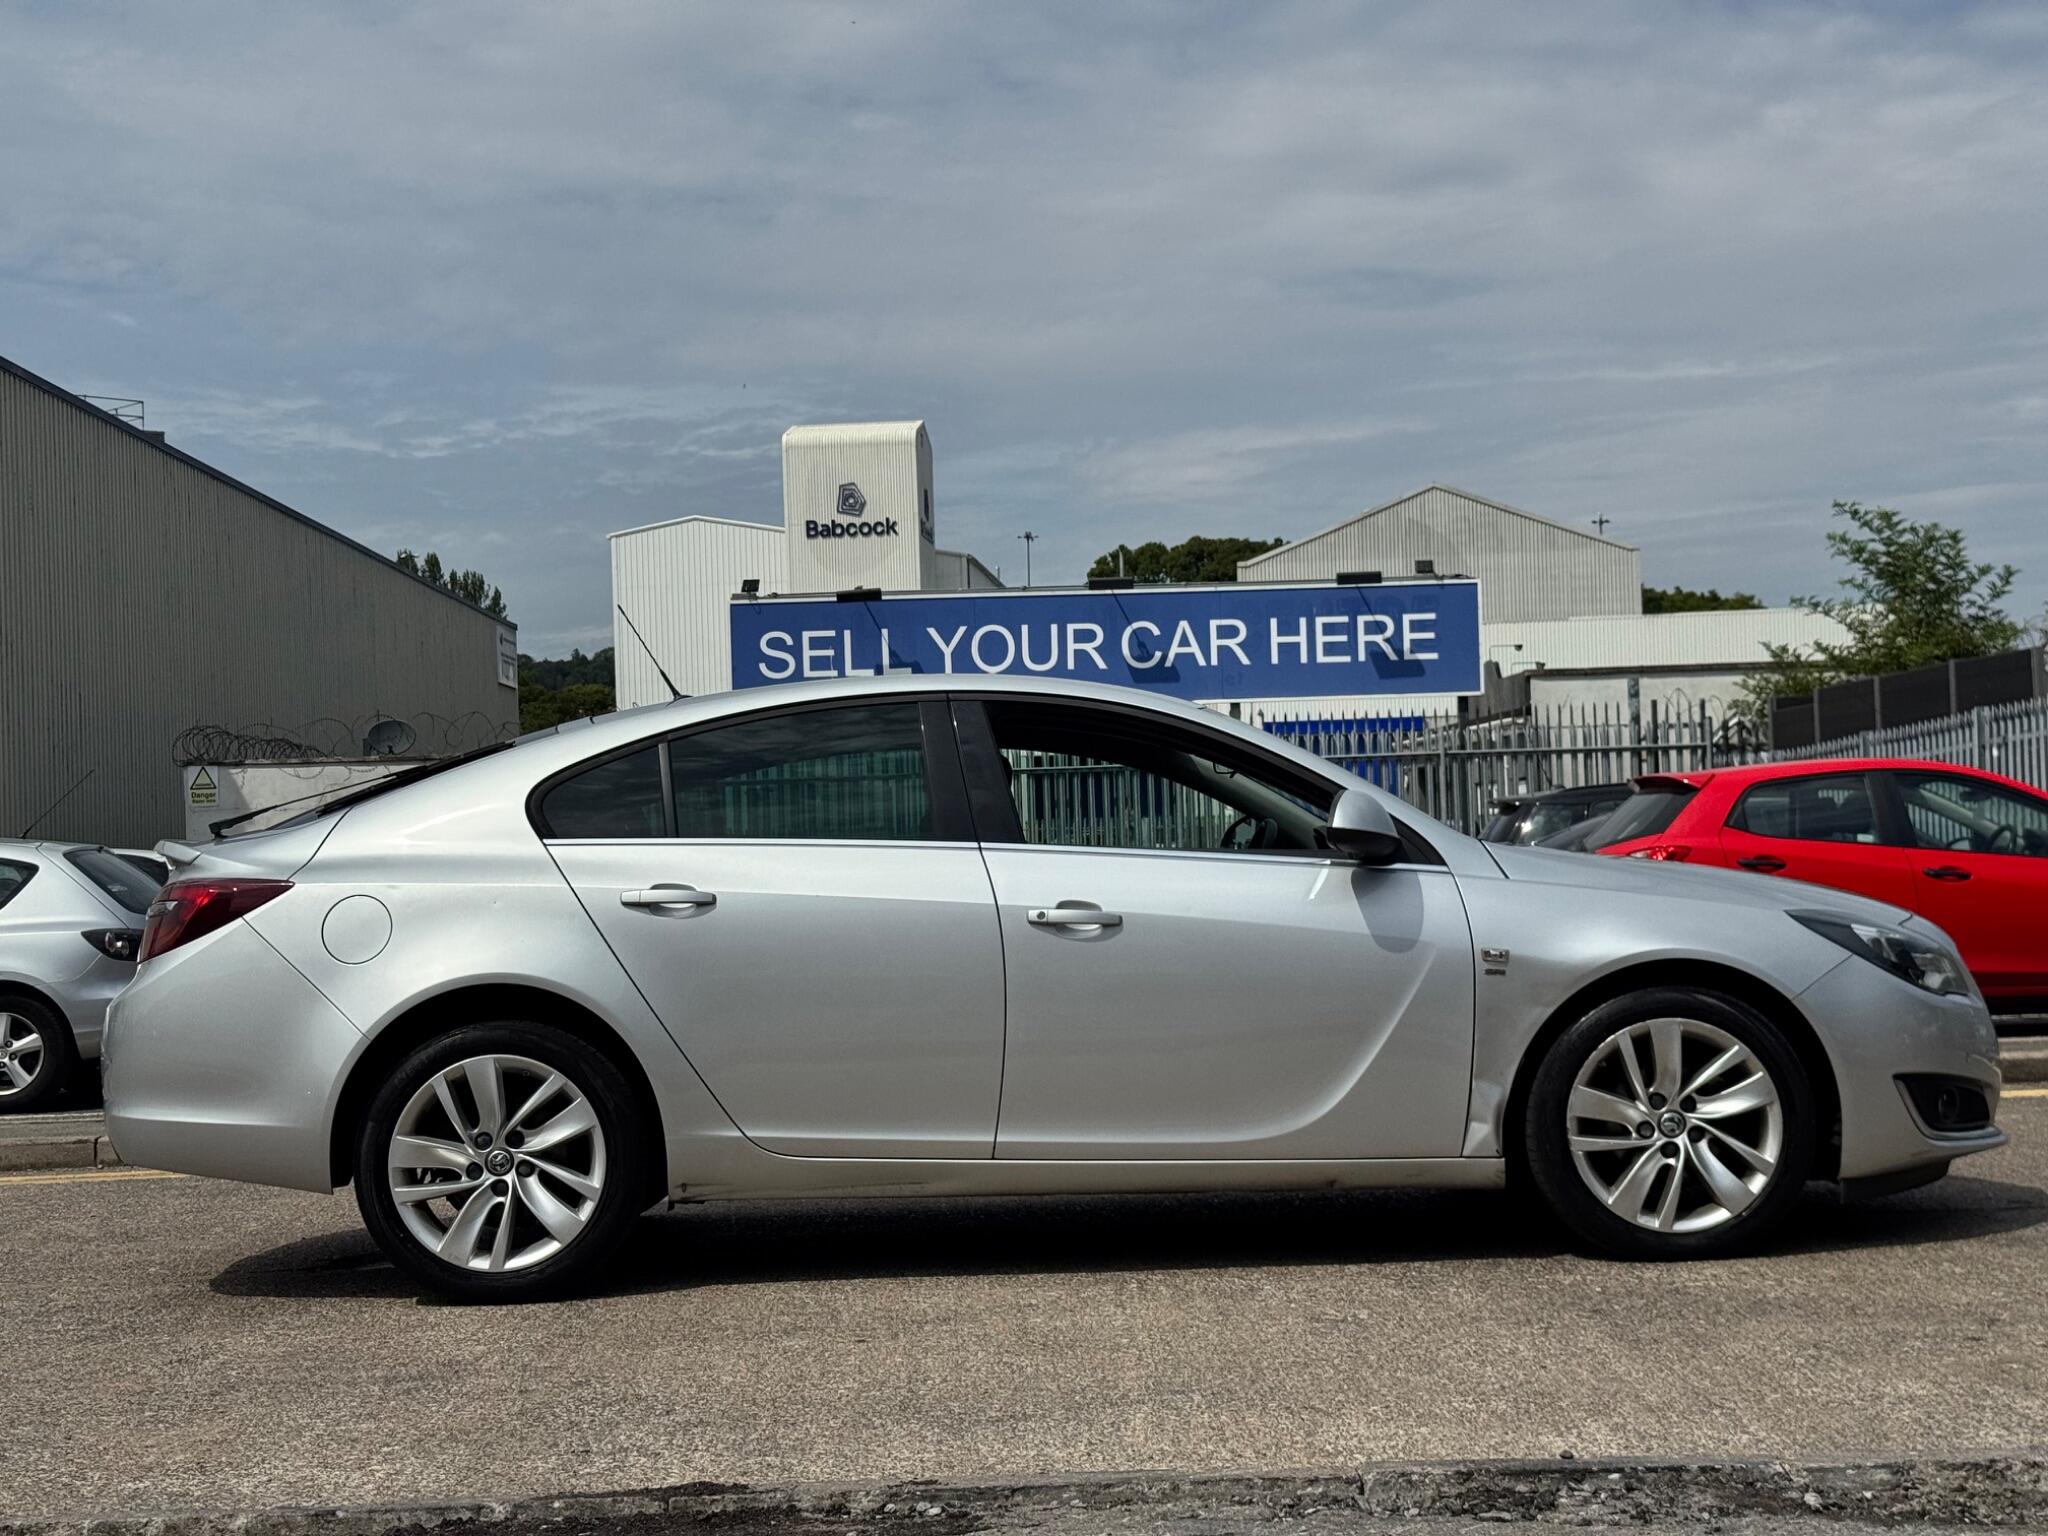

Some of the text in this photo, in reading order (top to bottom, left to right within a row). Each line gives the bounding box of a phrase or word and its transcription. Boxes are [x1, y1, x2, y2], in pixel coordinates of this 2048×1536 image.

[806, 517, 898, 539] Babcock
[758, 612, 1439, 679] SELL YOUR CAR HERE
[191, 791, 216, 800] Danger
